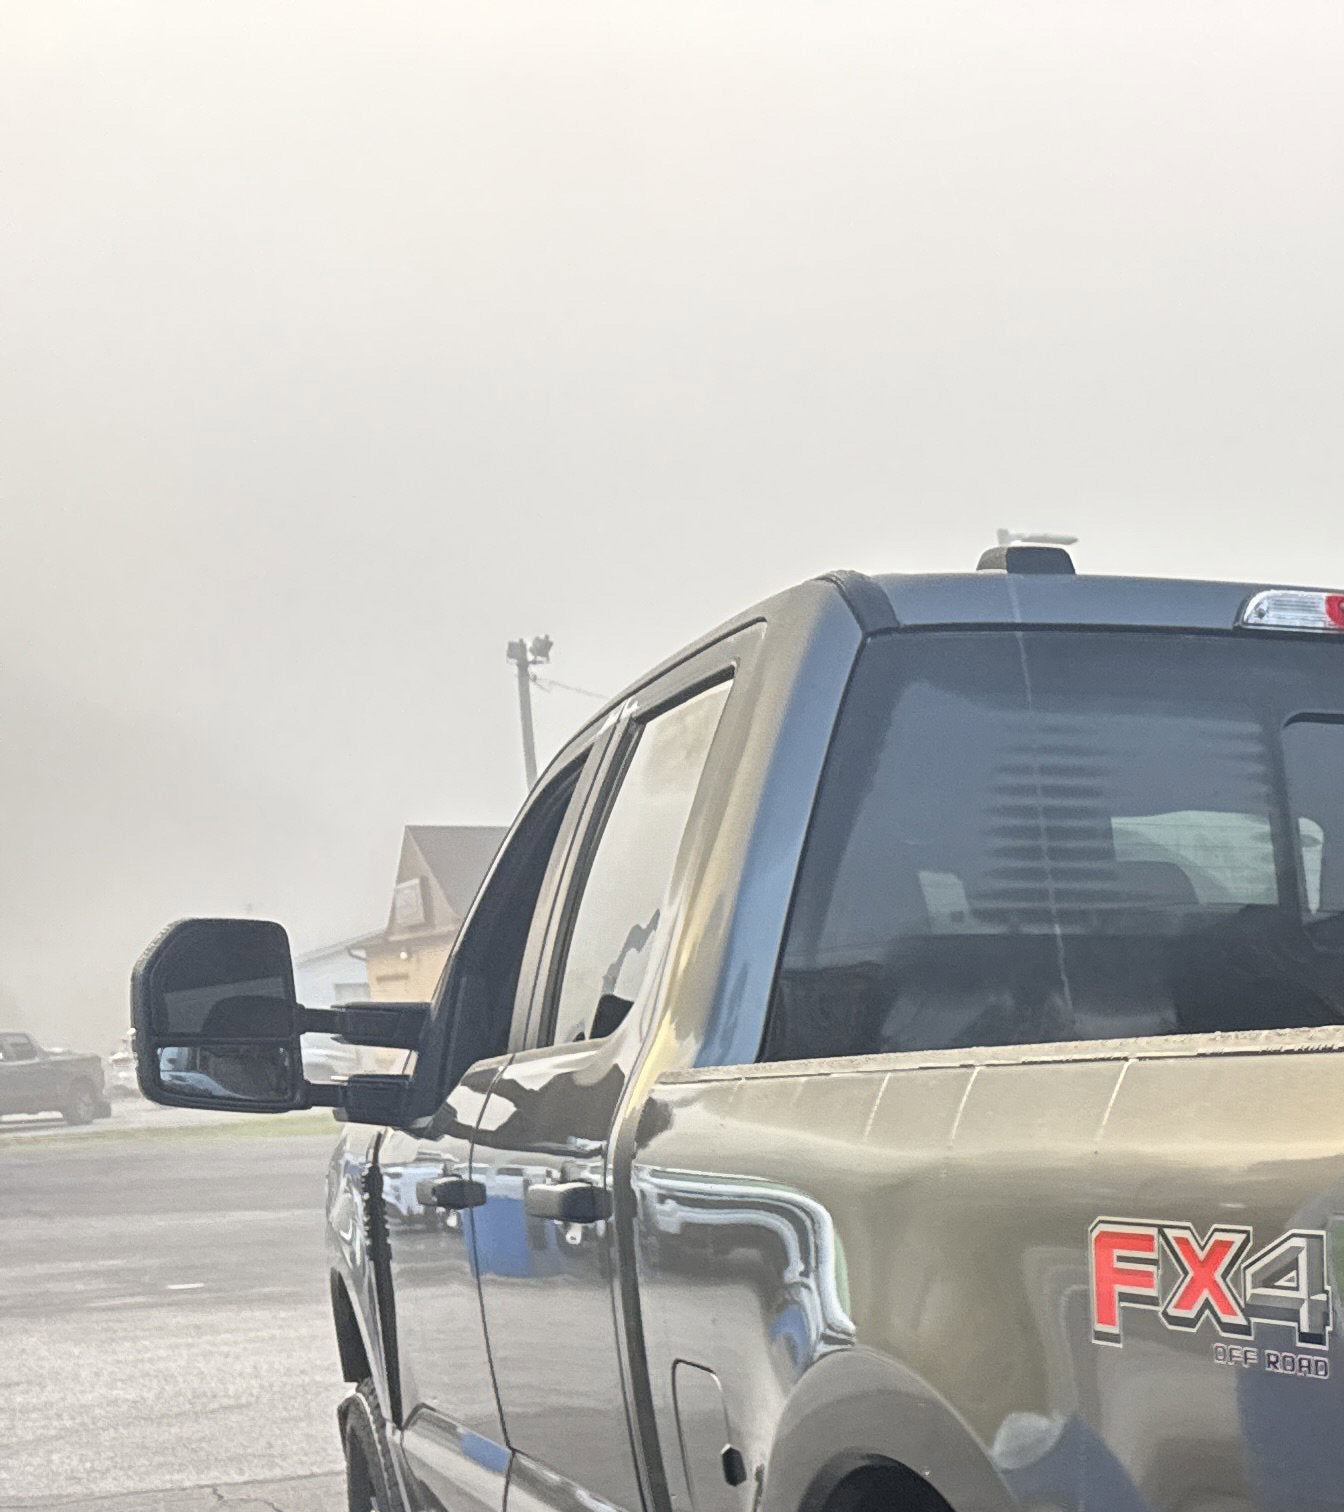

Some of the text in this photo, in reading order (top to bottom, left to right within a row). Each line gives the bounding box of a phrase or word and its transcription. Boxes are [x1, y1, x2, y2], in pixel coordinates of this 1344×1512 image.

[1088, 1216, 1333, 1350] FX4
[1212, 1342, 1330, 1379] OFF ROAD
